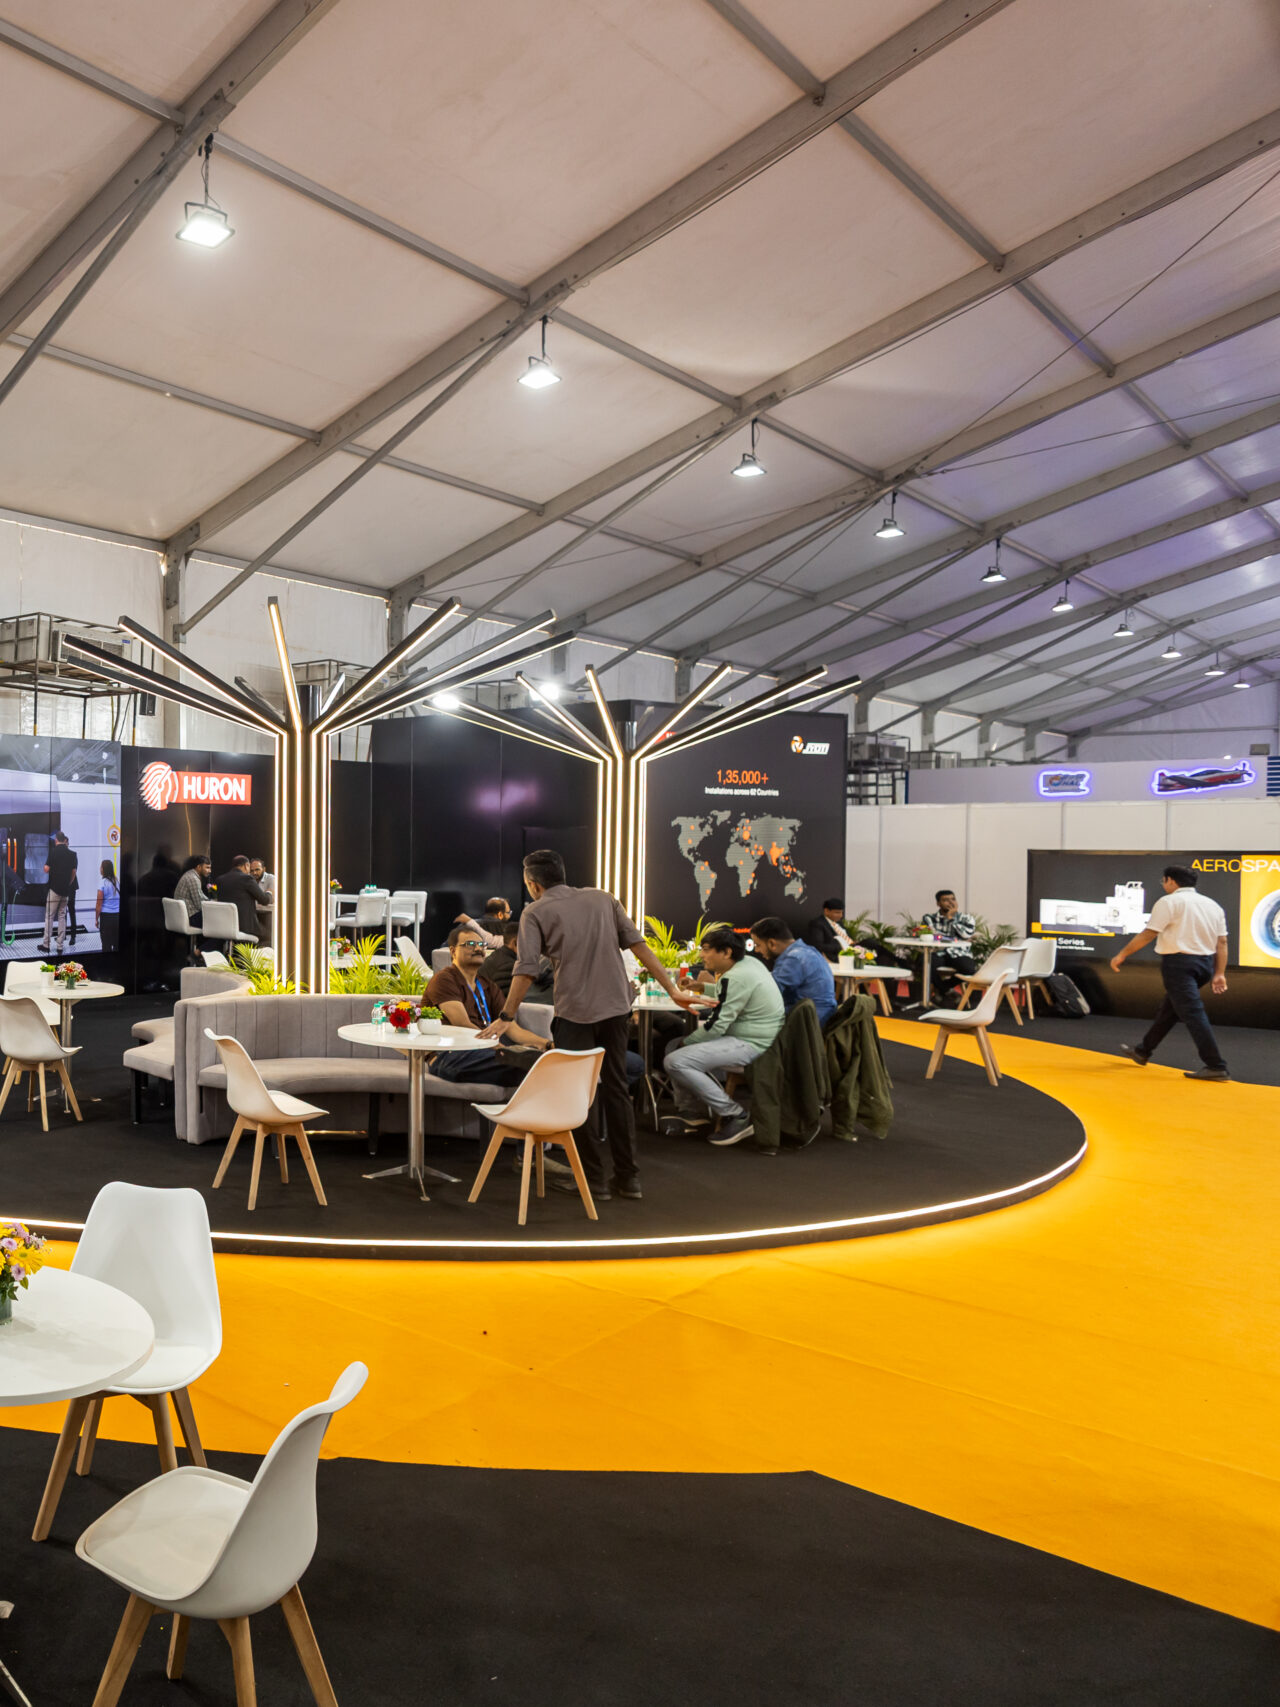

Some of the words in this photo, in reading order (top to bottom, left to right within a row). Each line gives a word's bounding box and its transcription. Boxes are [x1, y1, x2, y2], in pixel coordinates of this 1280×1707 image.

[717, 768, 769, 786] 1,35,000+
[183, 776, 246, 801] HURON
[1058, 937, 1085, 946] Series
